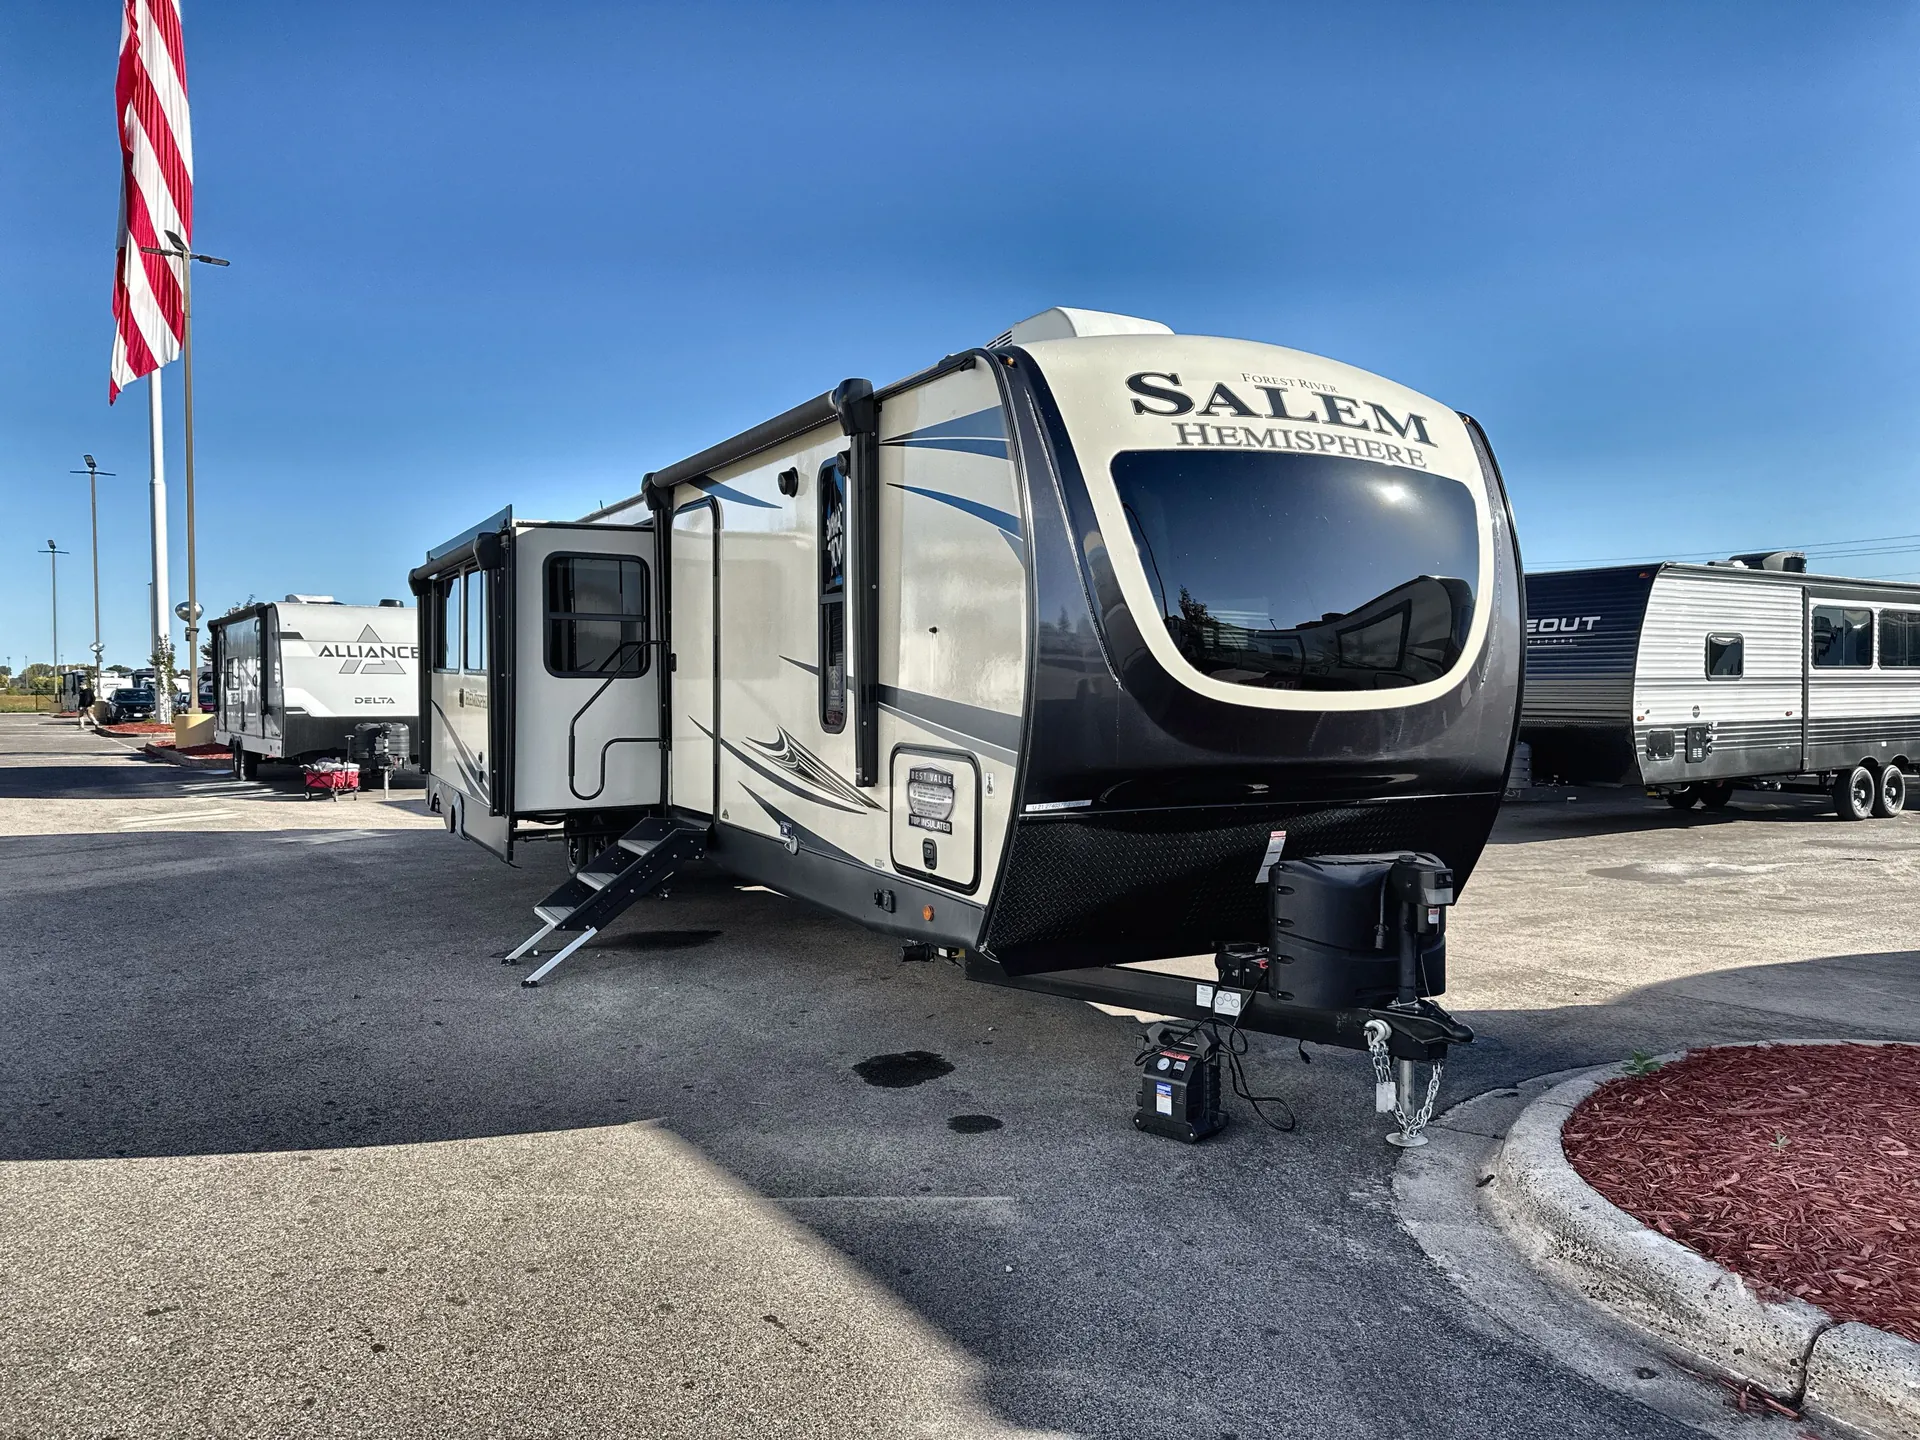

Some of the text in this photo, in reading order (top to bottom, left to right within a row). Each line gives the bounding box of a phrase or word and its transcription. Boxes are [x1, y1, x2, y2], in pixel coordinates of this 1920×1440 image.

[1240, 372, 1339, 393] FOREST RIVER
[1125, 372, 1438, 448] SALEM
[1171, 422, 1427, 469] HEMISPHERE
[1527, 616, 1601, 632] EOUT
[318, 644, 419, 659] ALLIANCE
[354, 696, 396, 704] DELTA
[911, 771, 952, 784] BEST VALUE
[921, 818, 951, 832] INSULATED
